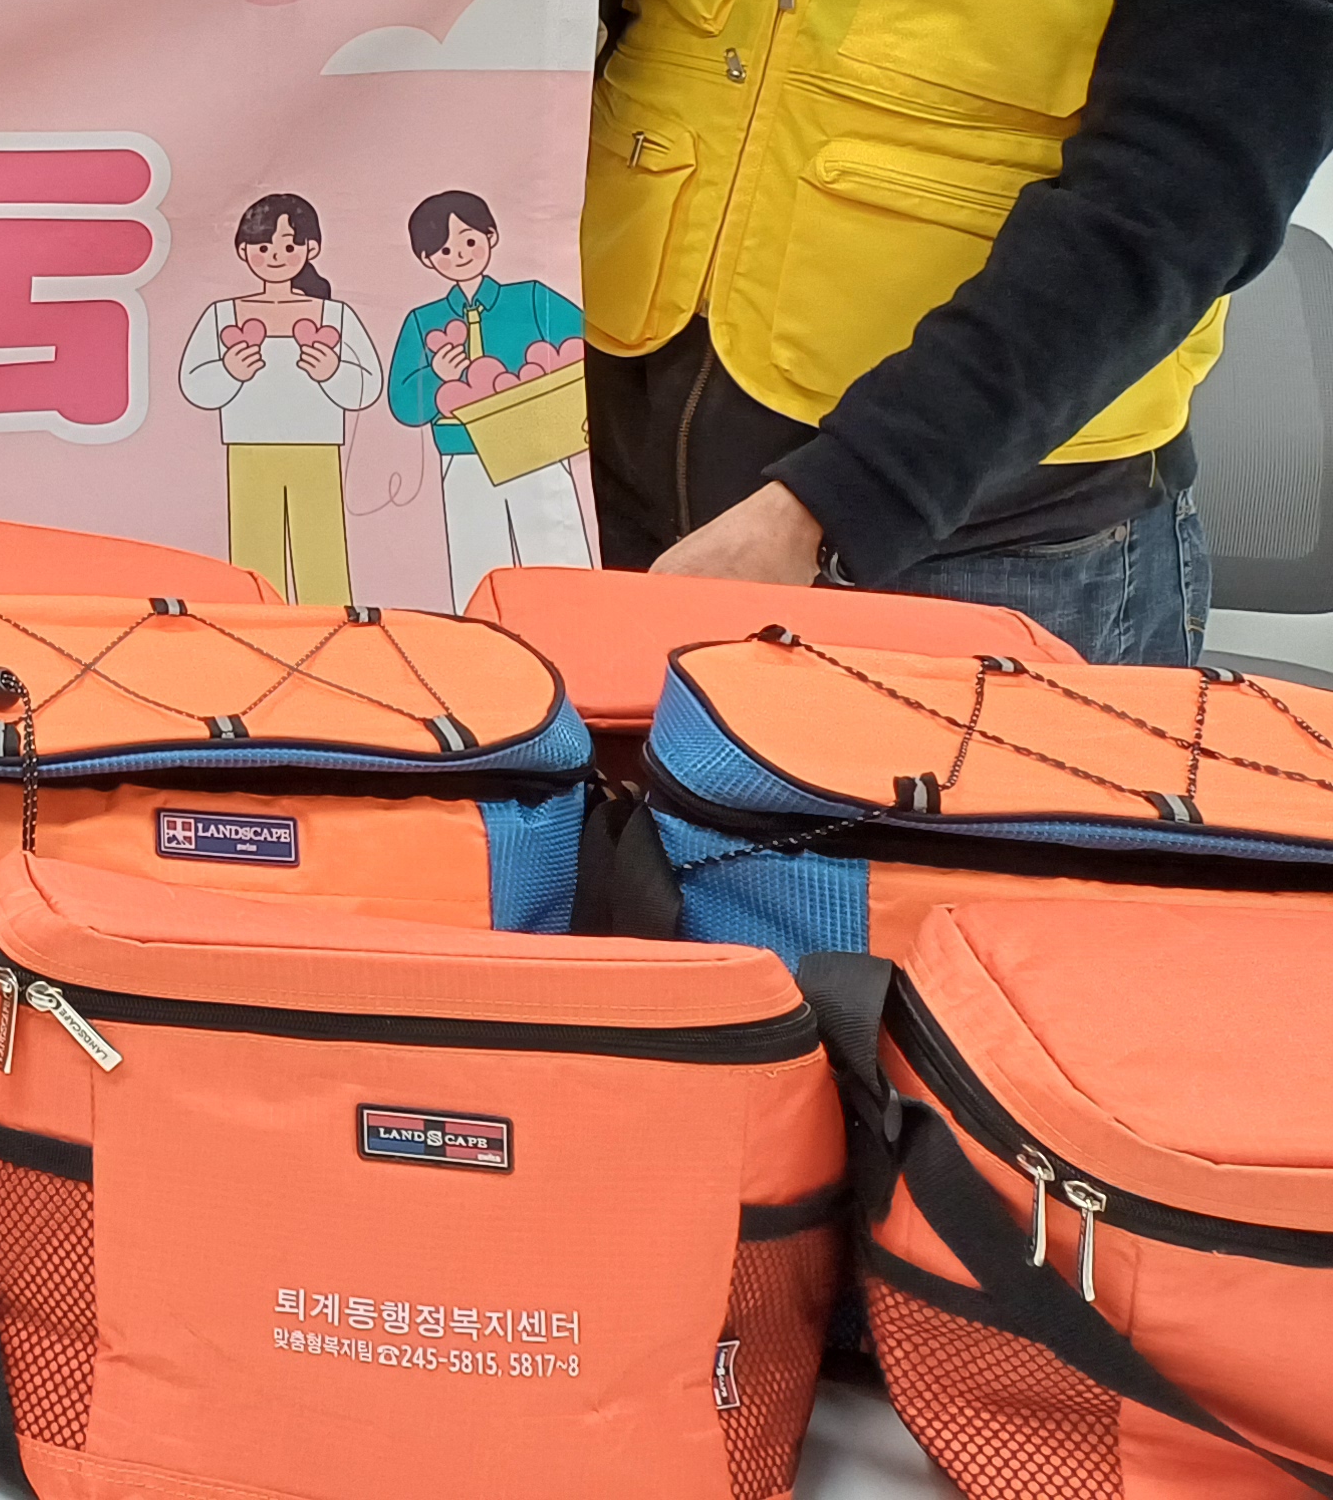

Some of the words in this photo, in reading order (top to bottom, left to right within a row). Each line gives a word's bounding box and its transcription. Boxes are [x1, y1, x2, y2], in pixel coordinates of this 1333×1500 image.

[196, 822, 291, 843] LANDSCAPE
[58, 1008, 109, 1061] LANDSCAPE
[378, 1127, 488, 1149] LANDSCAPE
[274, 1287, 580, 1345] 퇴계동행정복지센터
[273, 1327, 374, 1363] 맞춤형복지팀
[400, 1344, 504, 1378] 245-5815,
[509, 1352, 580, 1378] 5817~8
